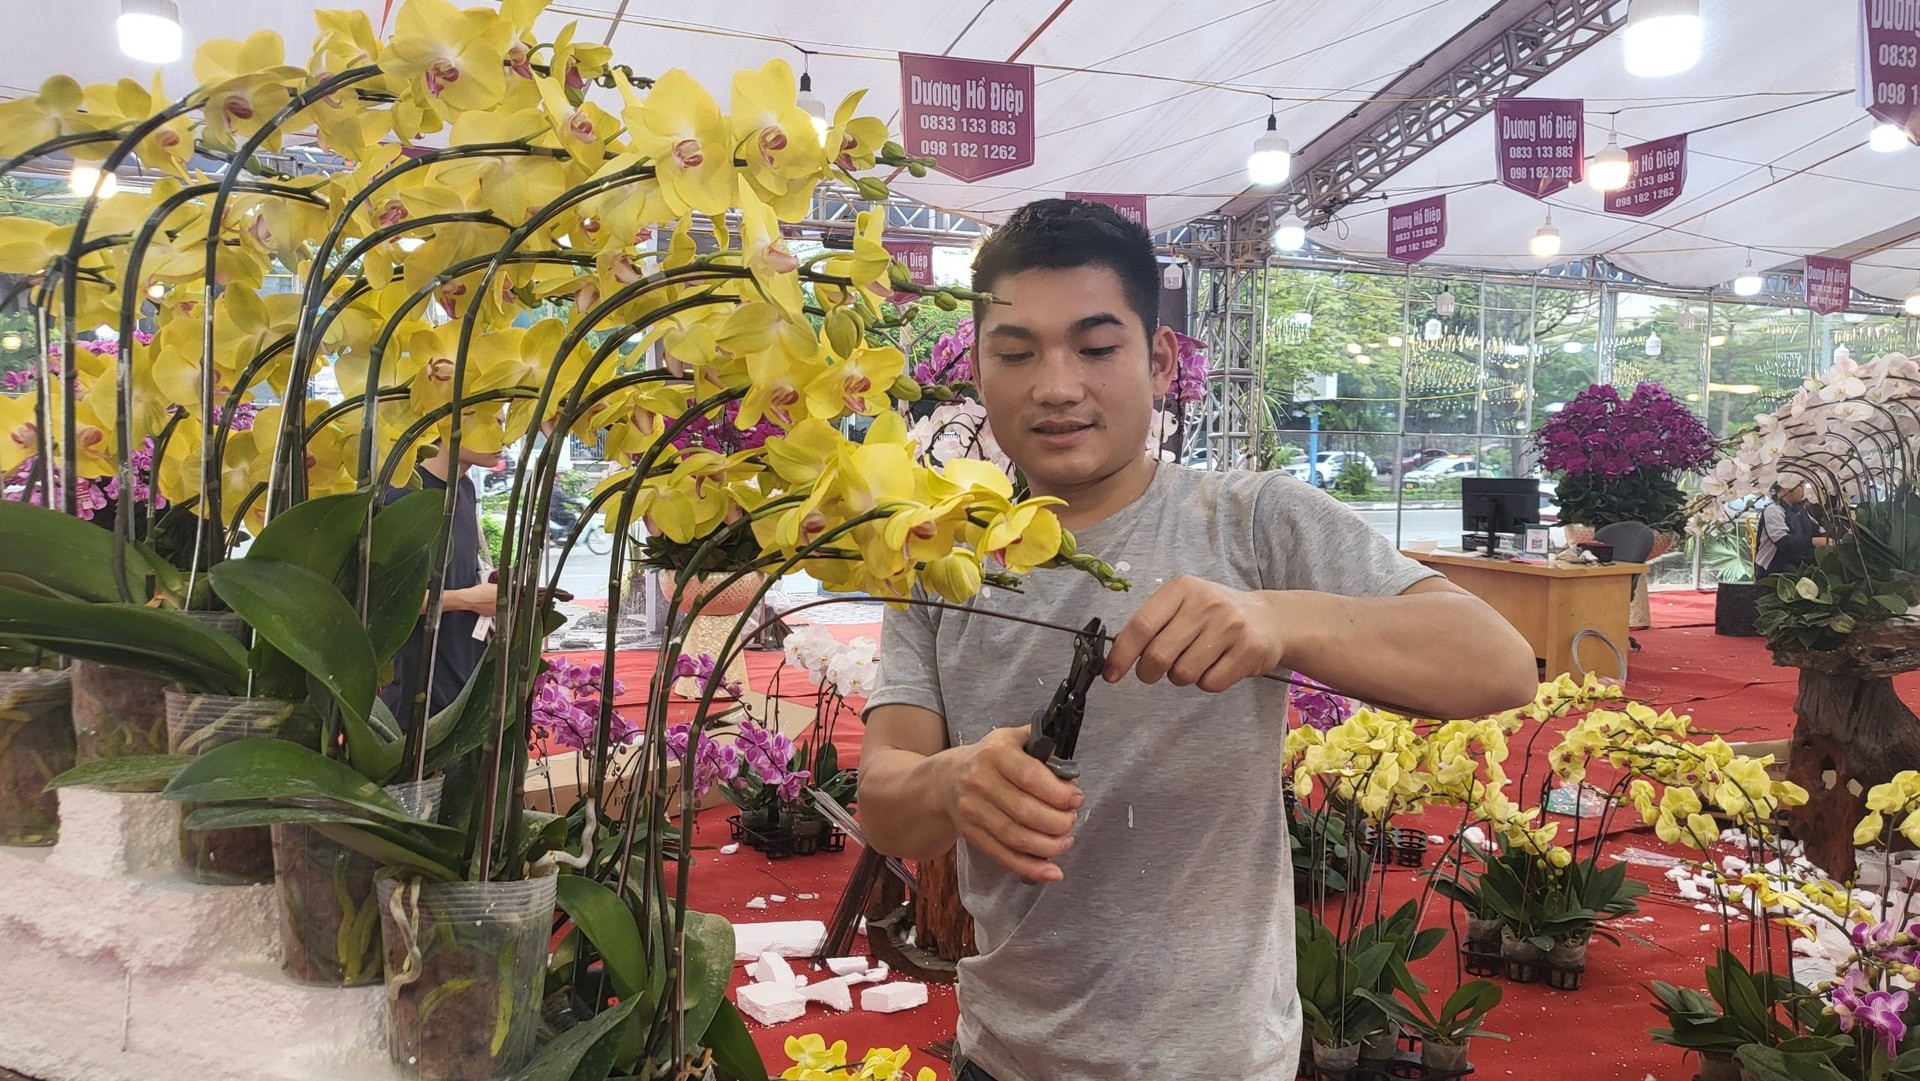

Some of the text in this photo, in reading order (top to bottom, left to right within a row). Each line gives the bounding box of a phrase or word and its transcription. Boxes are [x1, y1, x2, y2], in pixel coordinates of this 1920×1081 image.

[1878, 43, 1918, 68] 0833
[911, 75, 1024, 119] Dương Hồ Điệp
[1877, 82, 1906, 105] 098
[920, 114, 1016, 136] 0833 133 883
[1503, 111, 1577, 144] Dương Hồ Điệp
[920, 139, 1017, 160] 098 182 1262
[1509, 146, 1574, 159] 0833 133 883
[1641, 149, 1654, 173] Hồ
[1656, 147, 1680, 171] Điệp
[1510, 166, 1573, 179] 098 182 1262
[1638, 175, 1655, 188] 133
[1657, 171, 1675, 184] 883
[1615, 187, 1675, 208] 098 182 1262
